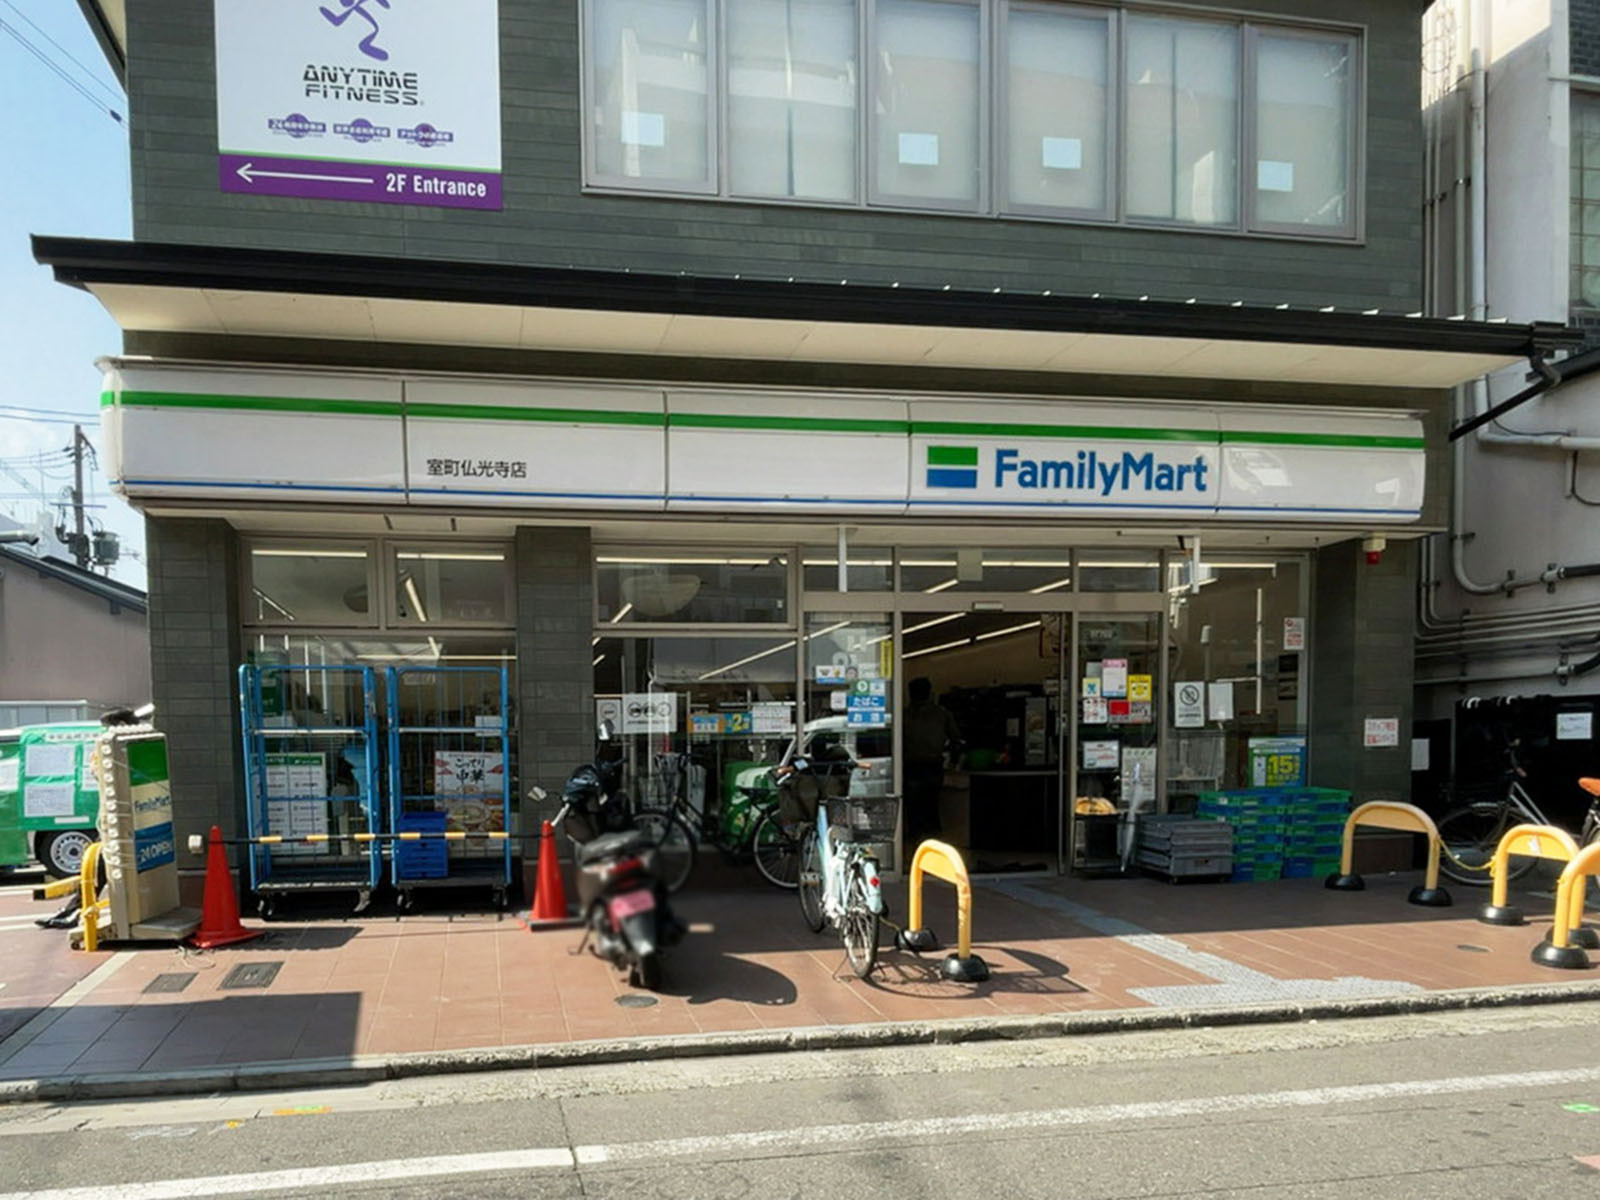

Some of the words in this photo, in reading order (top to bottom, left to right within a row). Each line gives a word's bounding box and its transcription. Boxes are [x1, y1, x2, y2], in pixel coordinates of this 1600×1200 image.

[303, 64, 418, 90] ANYTIME
[305, 83, 418, 105] FITNESS
[386, 173, 407, 193] 2F
[413, 175, 487, 197] Entrance
[426, 458, 527, 479] 室町仏光寺店
[995, 448, 1208, 496] FamilyMart
